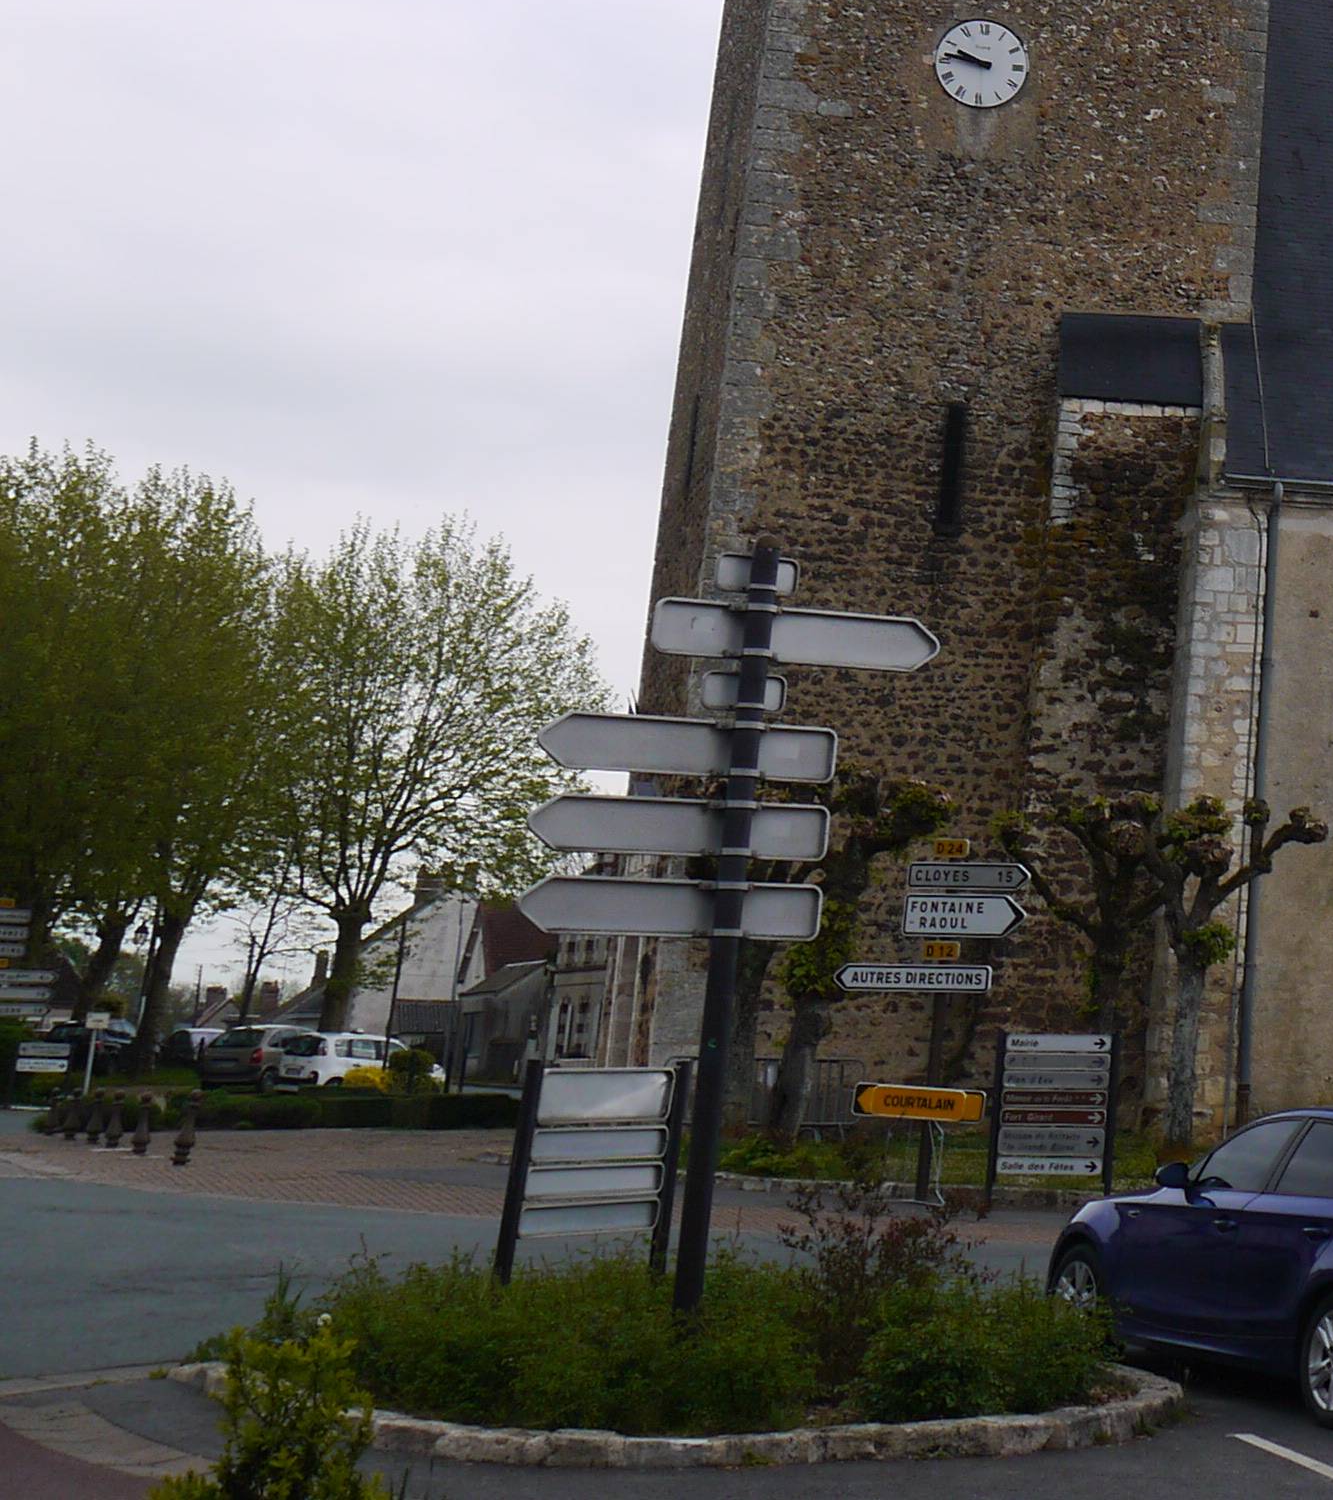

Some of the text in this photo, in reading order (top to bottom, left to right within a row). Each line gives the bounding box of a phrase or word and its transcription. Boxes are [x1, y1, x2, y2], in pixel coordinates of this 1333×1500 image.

[936, 843, 963, 854] D 24
[915, 870, 1013, 882] CLOYES 15
[910, 901, 985, 914] FONTAINE
[926, 945, 954, 957] D 12
[851, 971, 983, 985] AUTRES DIRECTIONS
[1010, 1038, 1040, 1048] Mairie
[883, 1094, 955, 1111] COURTALAIN
[1001, 1161, 1075, 1171] Salle des Fêtes
